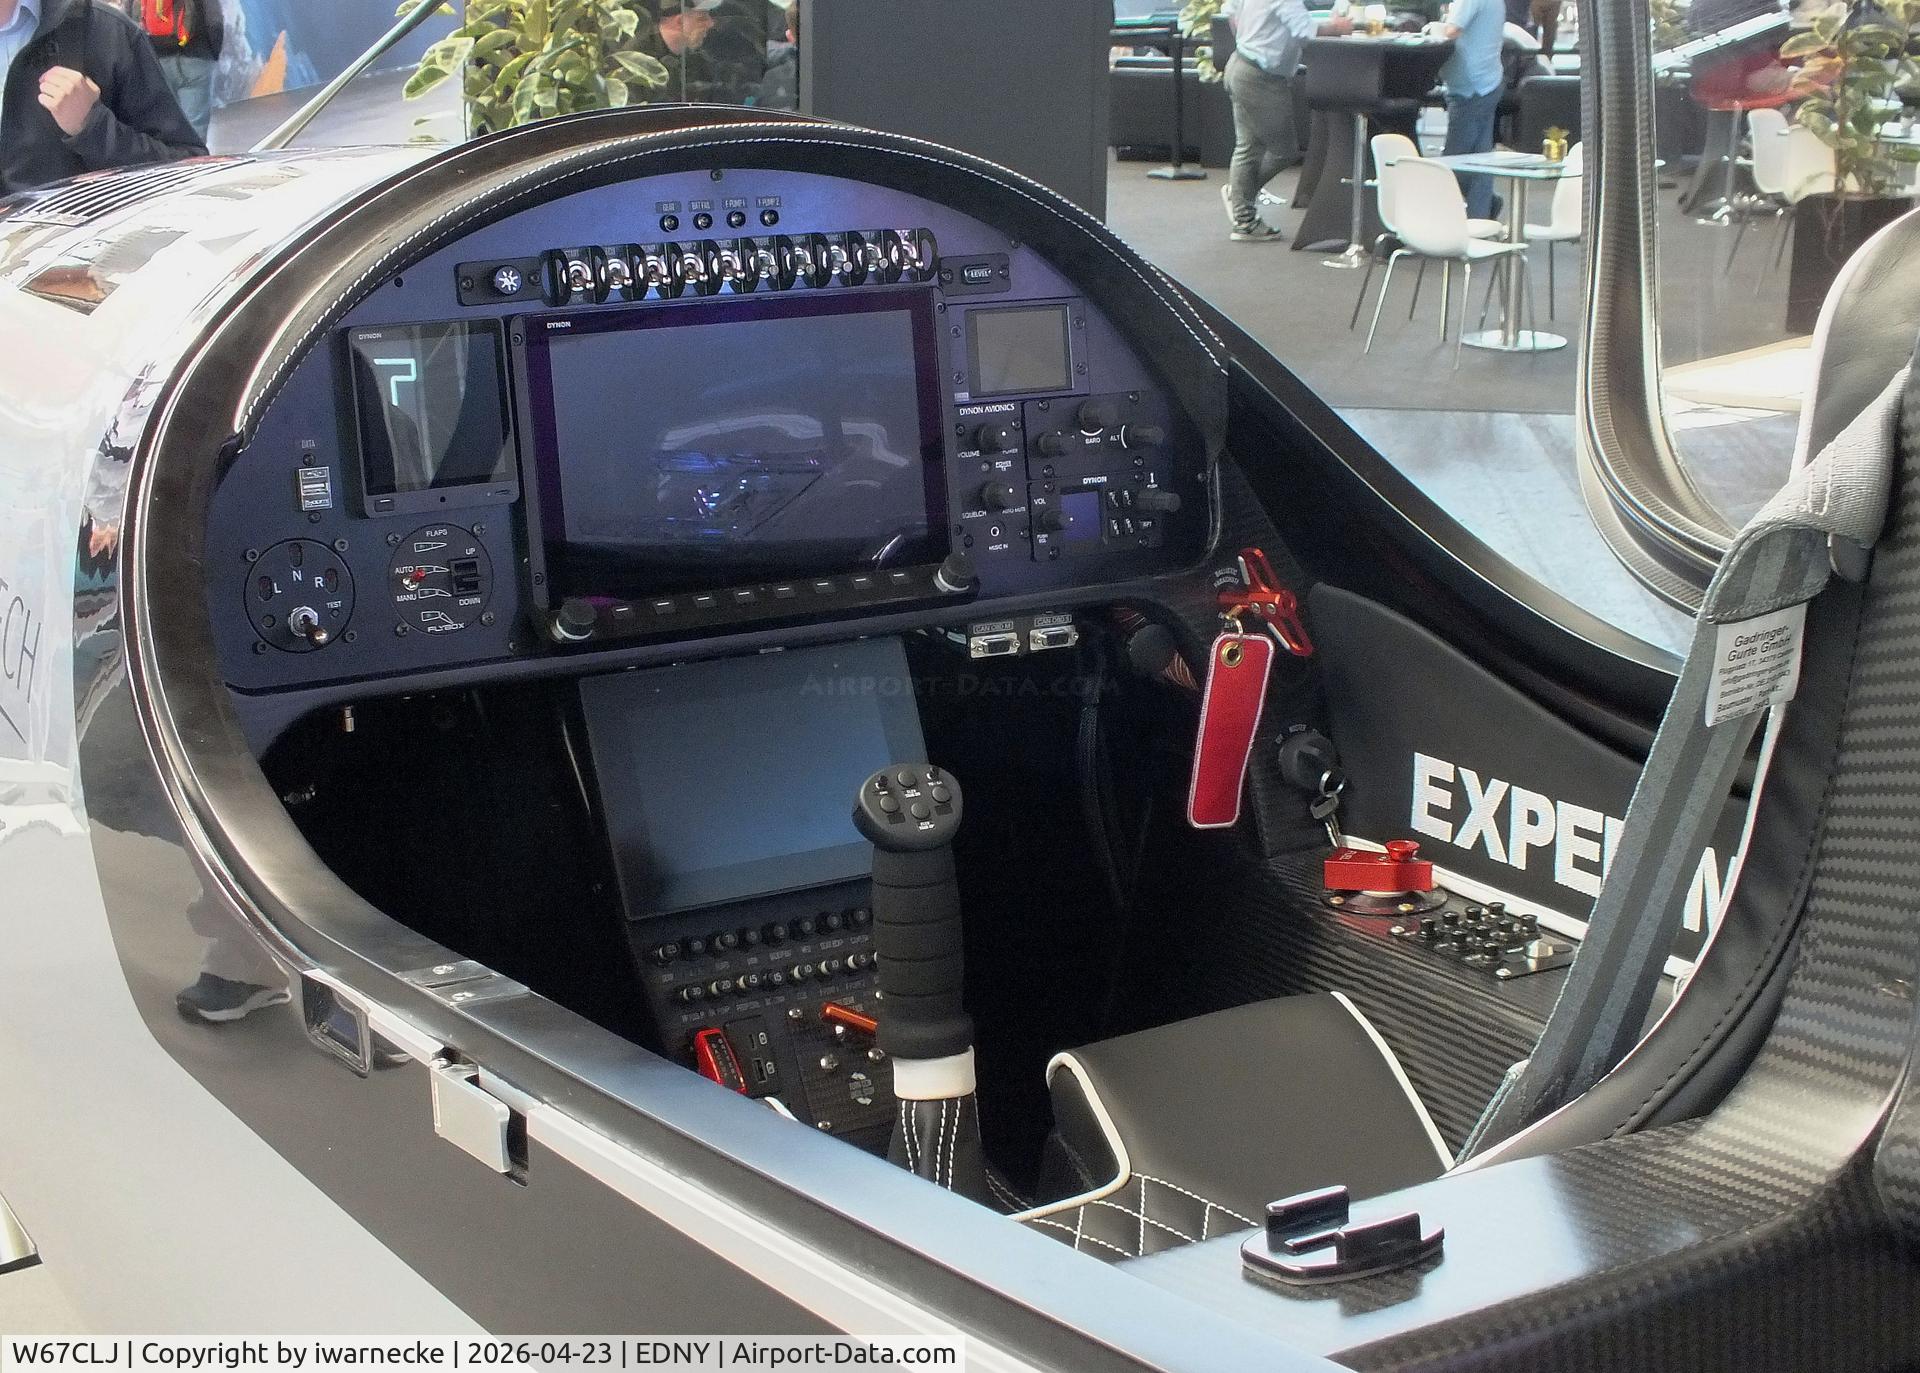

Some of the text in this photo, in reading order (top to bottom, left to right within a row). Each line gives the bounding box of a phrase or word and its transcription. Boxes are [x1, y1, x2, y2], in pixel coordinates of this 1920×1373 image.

[546, 320, 572, 329] DYNON
[959, 403, 1015, 416] DYNON AVIONICS
[1082, 475, 1107, 485] DYNON
[426, 528, 448, 537] FLAPS
[465, 547, 476, 555] UP
[394, 566, 414, 575] AUTO
[292, 570, 303, 581] N
[314, 576, 324, 588] R
[273, 582, 282, 594] L
[326, 600, 342, 608] TEST
[458, 597, 481, 606] DOWN
[1728, 646, 1758, 662] Gurte
[1760, 634, 1791, 654] GmbH
